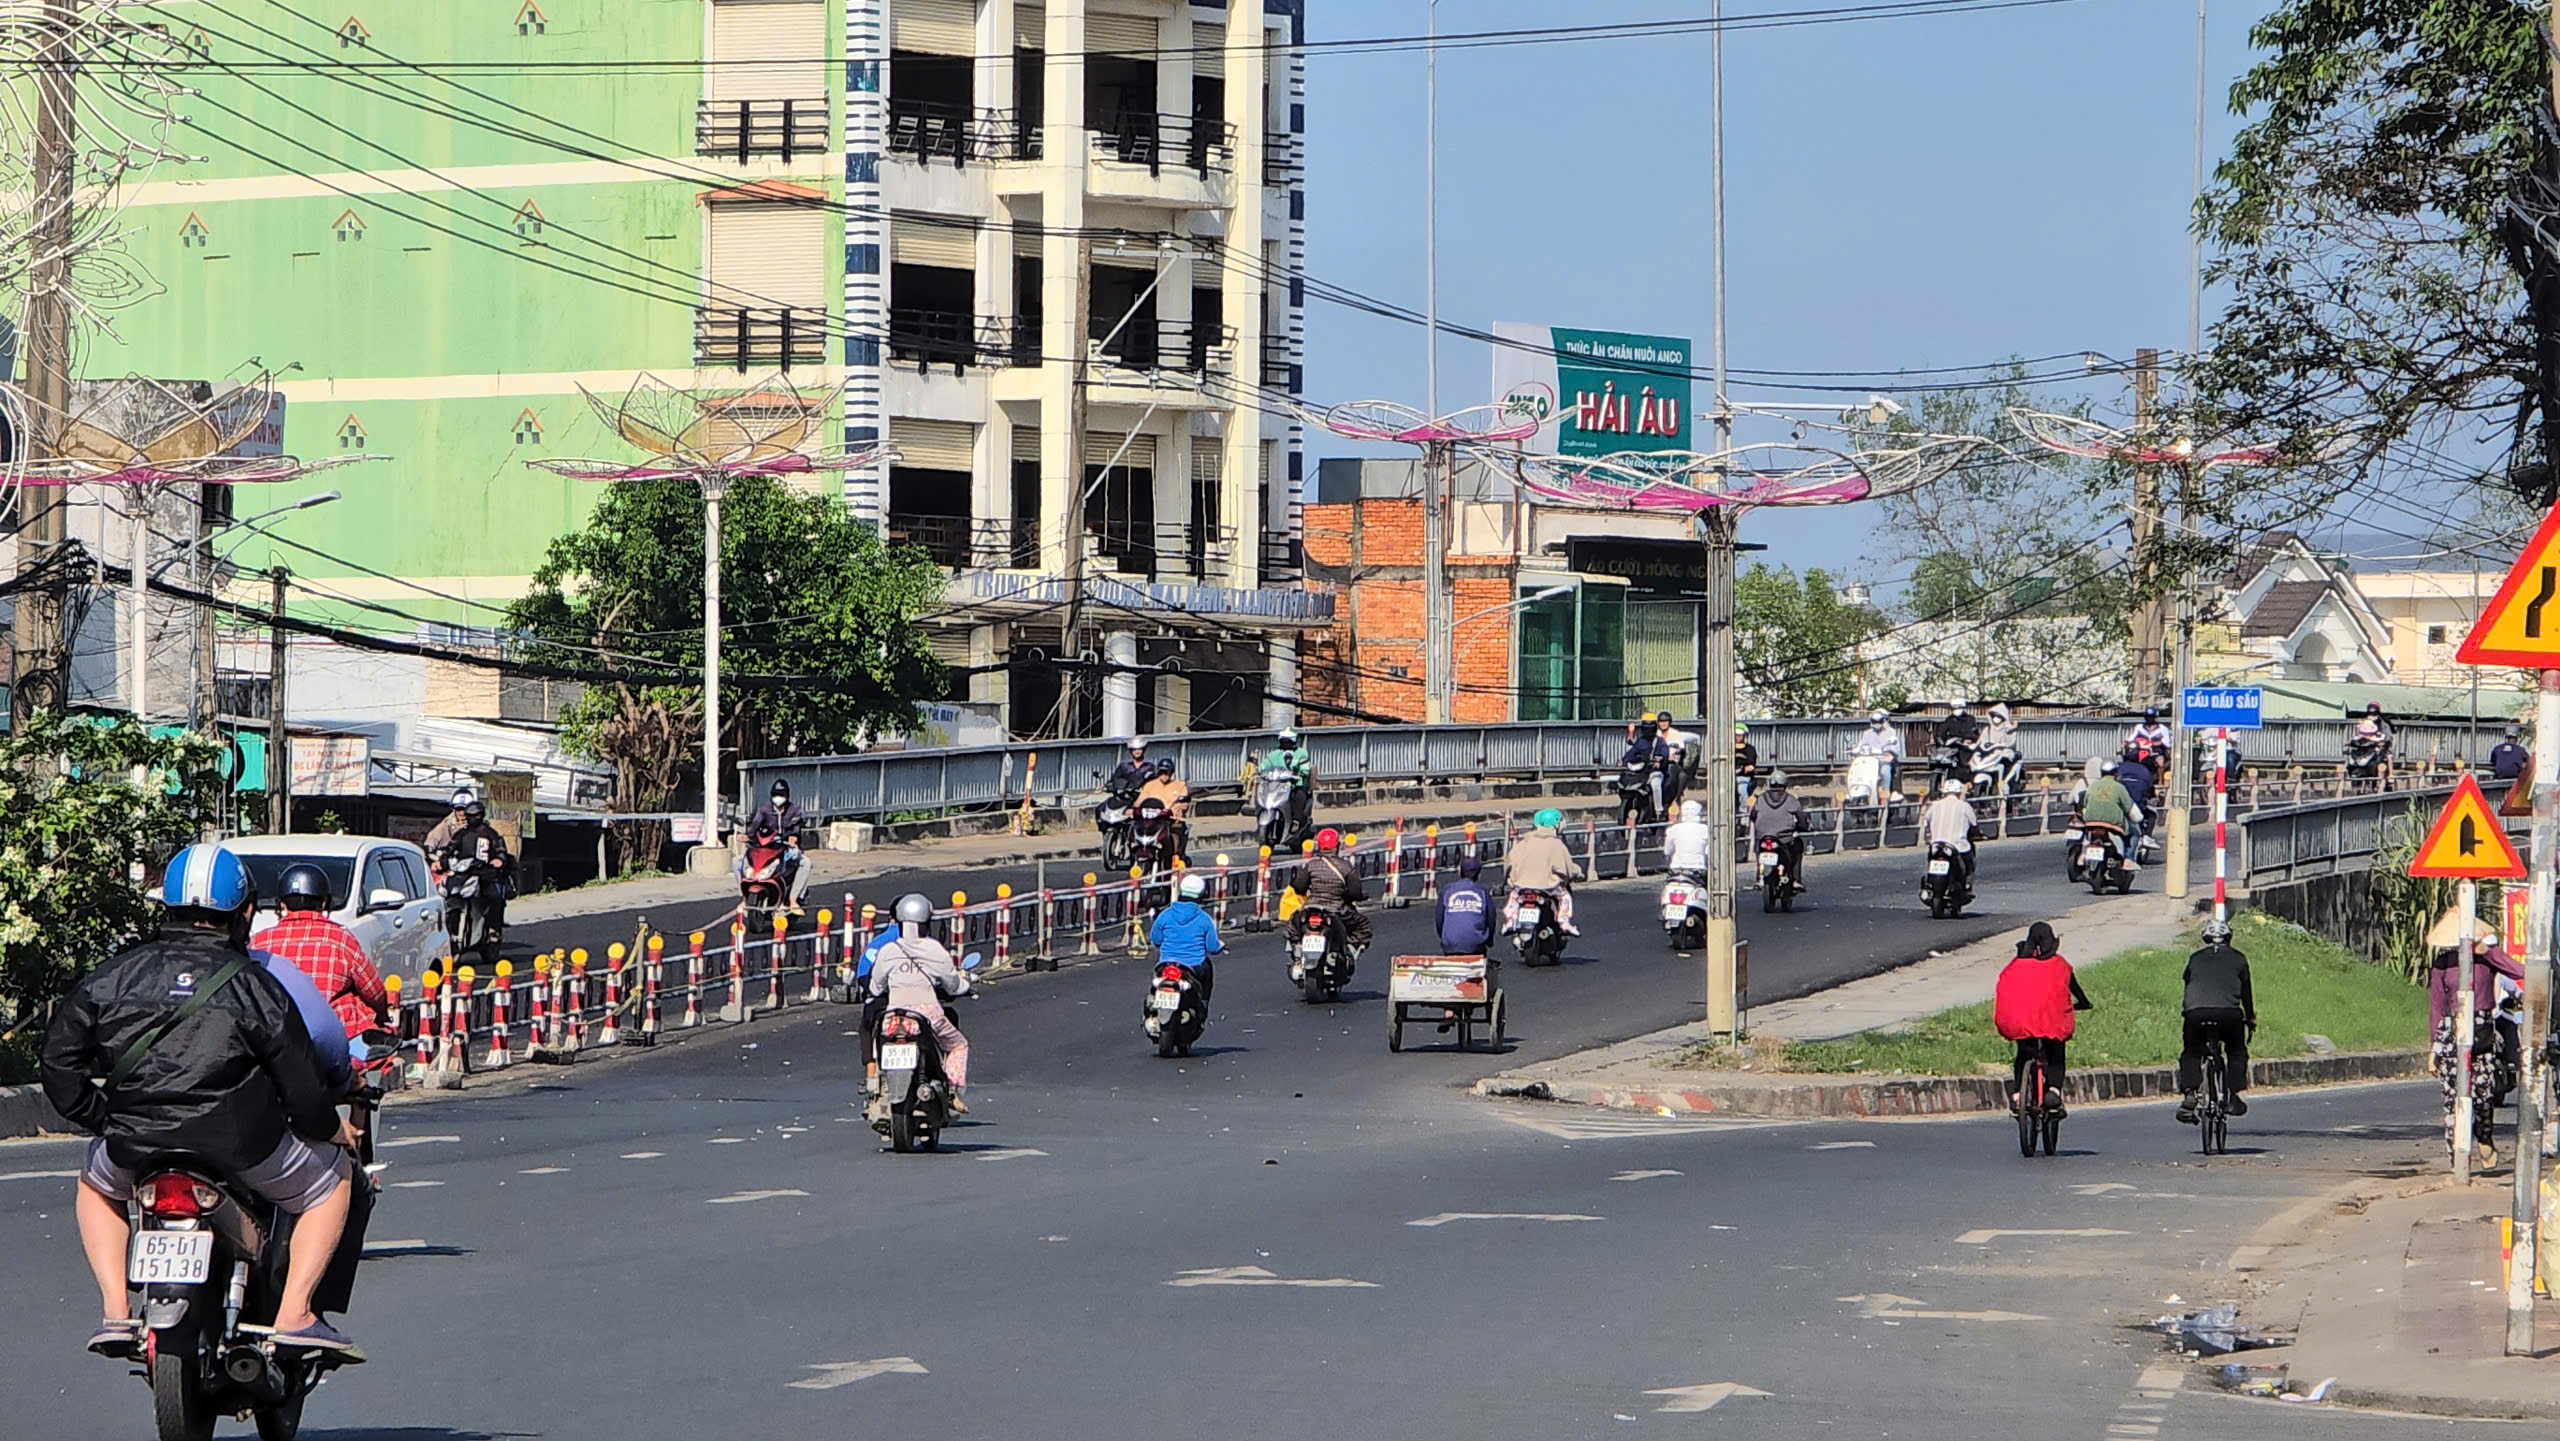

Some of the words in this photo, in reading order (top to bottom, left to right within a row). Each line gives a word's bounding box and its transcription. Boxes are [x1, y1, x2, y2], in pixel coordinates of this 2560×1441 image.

[1657, 350, 1683, 364] ANCO
[1576, 380, 1630, 434] HẢI
[1637, 385, 1681, 437] ÂU
[137, 1258, 203, 1278] 151.38
